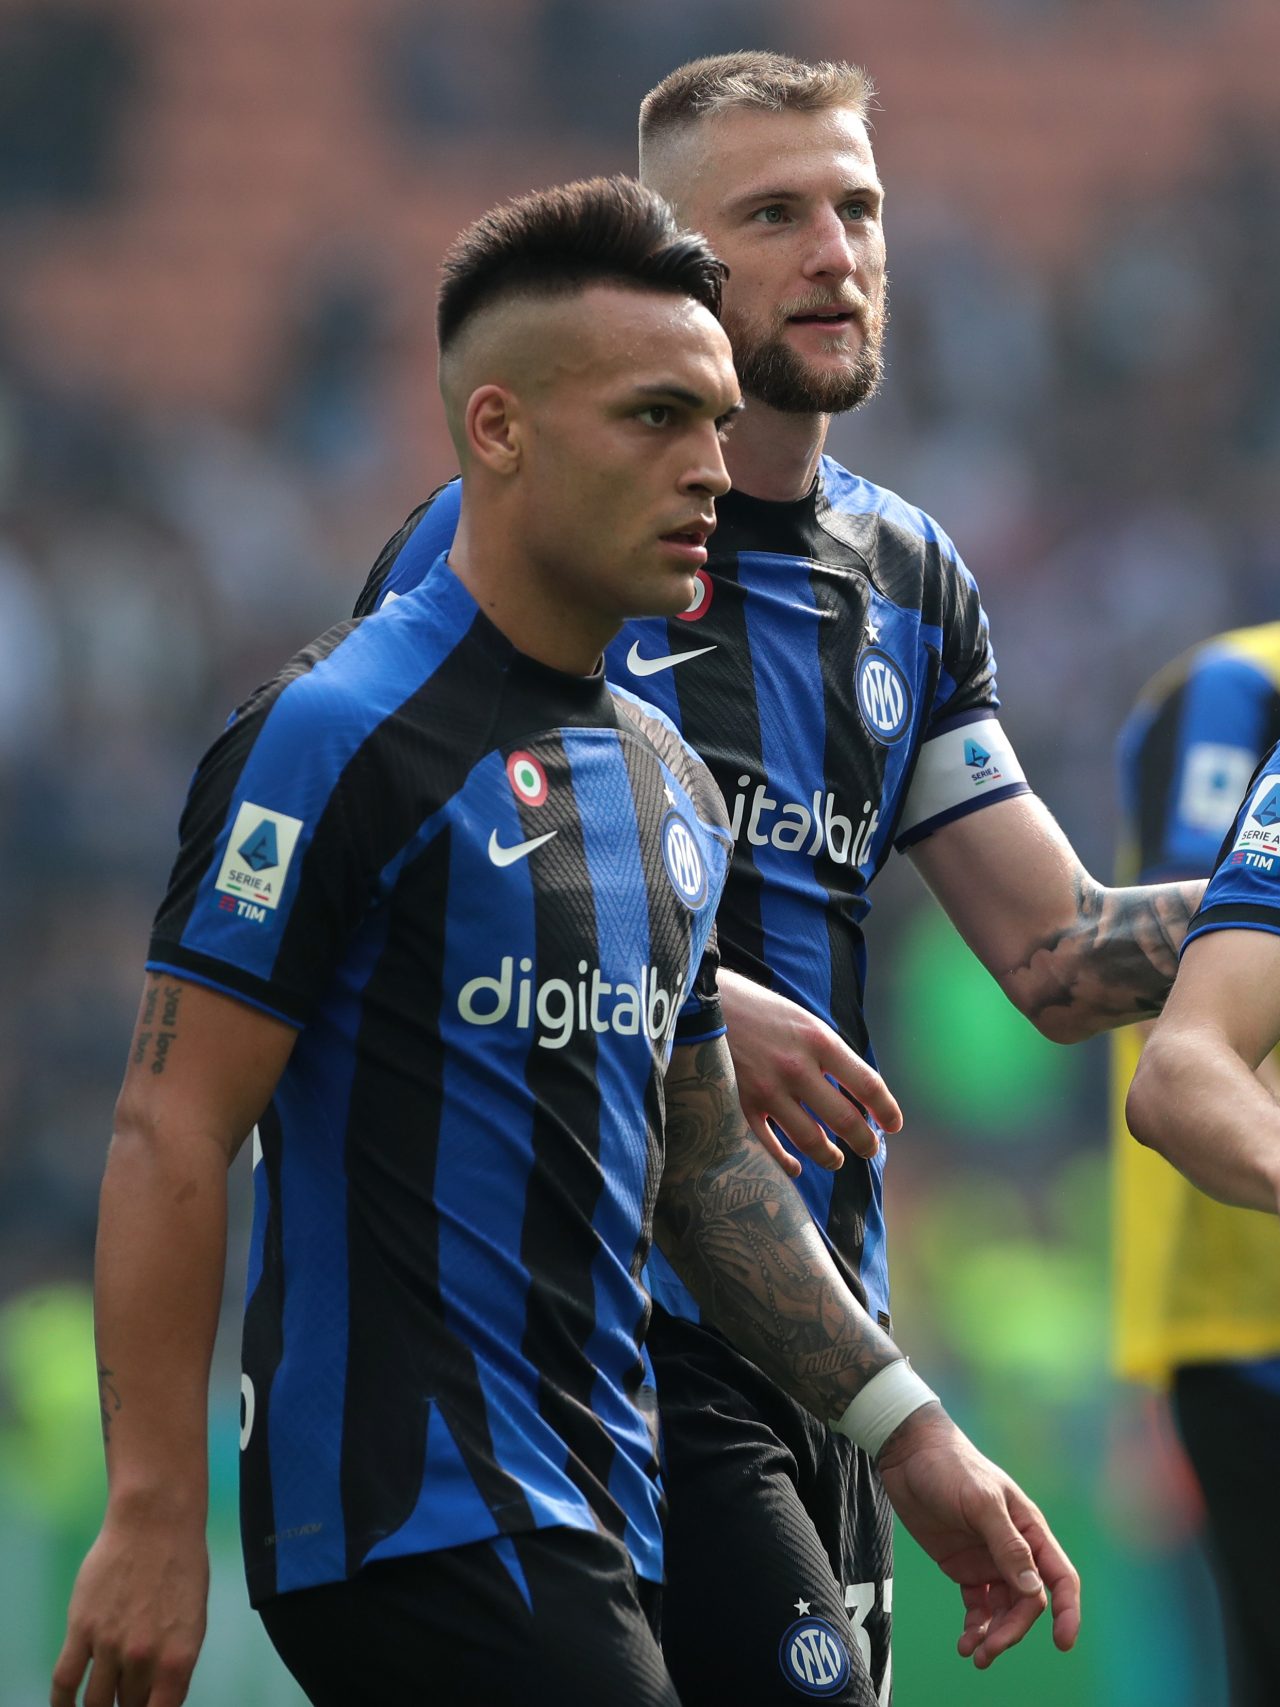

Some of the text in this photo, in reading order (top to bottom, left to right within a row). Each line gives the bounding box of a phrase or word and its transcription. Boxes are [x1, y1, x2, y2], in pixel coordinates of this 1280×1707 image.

[971, 767, 993, 781] SERIE
[1241, 830, 1280, 845] SERIE A
[1245, 852, 1274, 871] TIM
[228, 869, 273, 894] SERIE A
[237, 900, 267, 923] TIM
